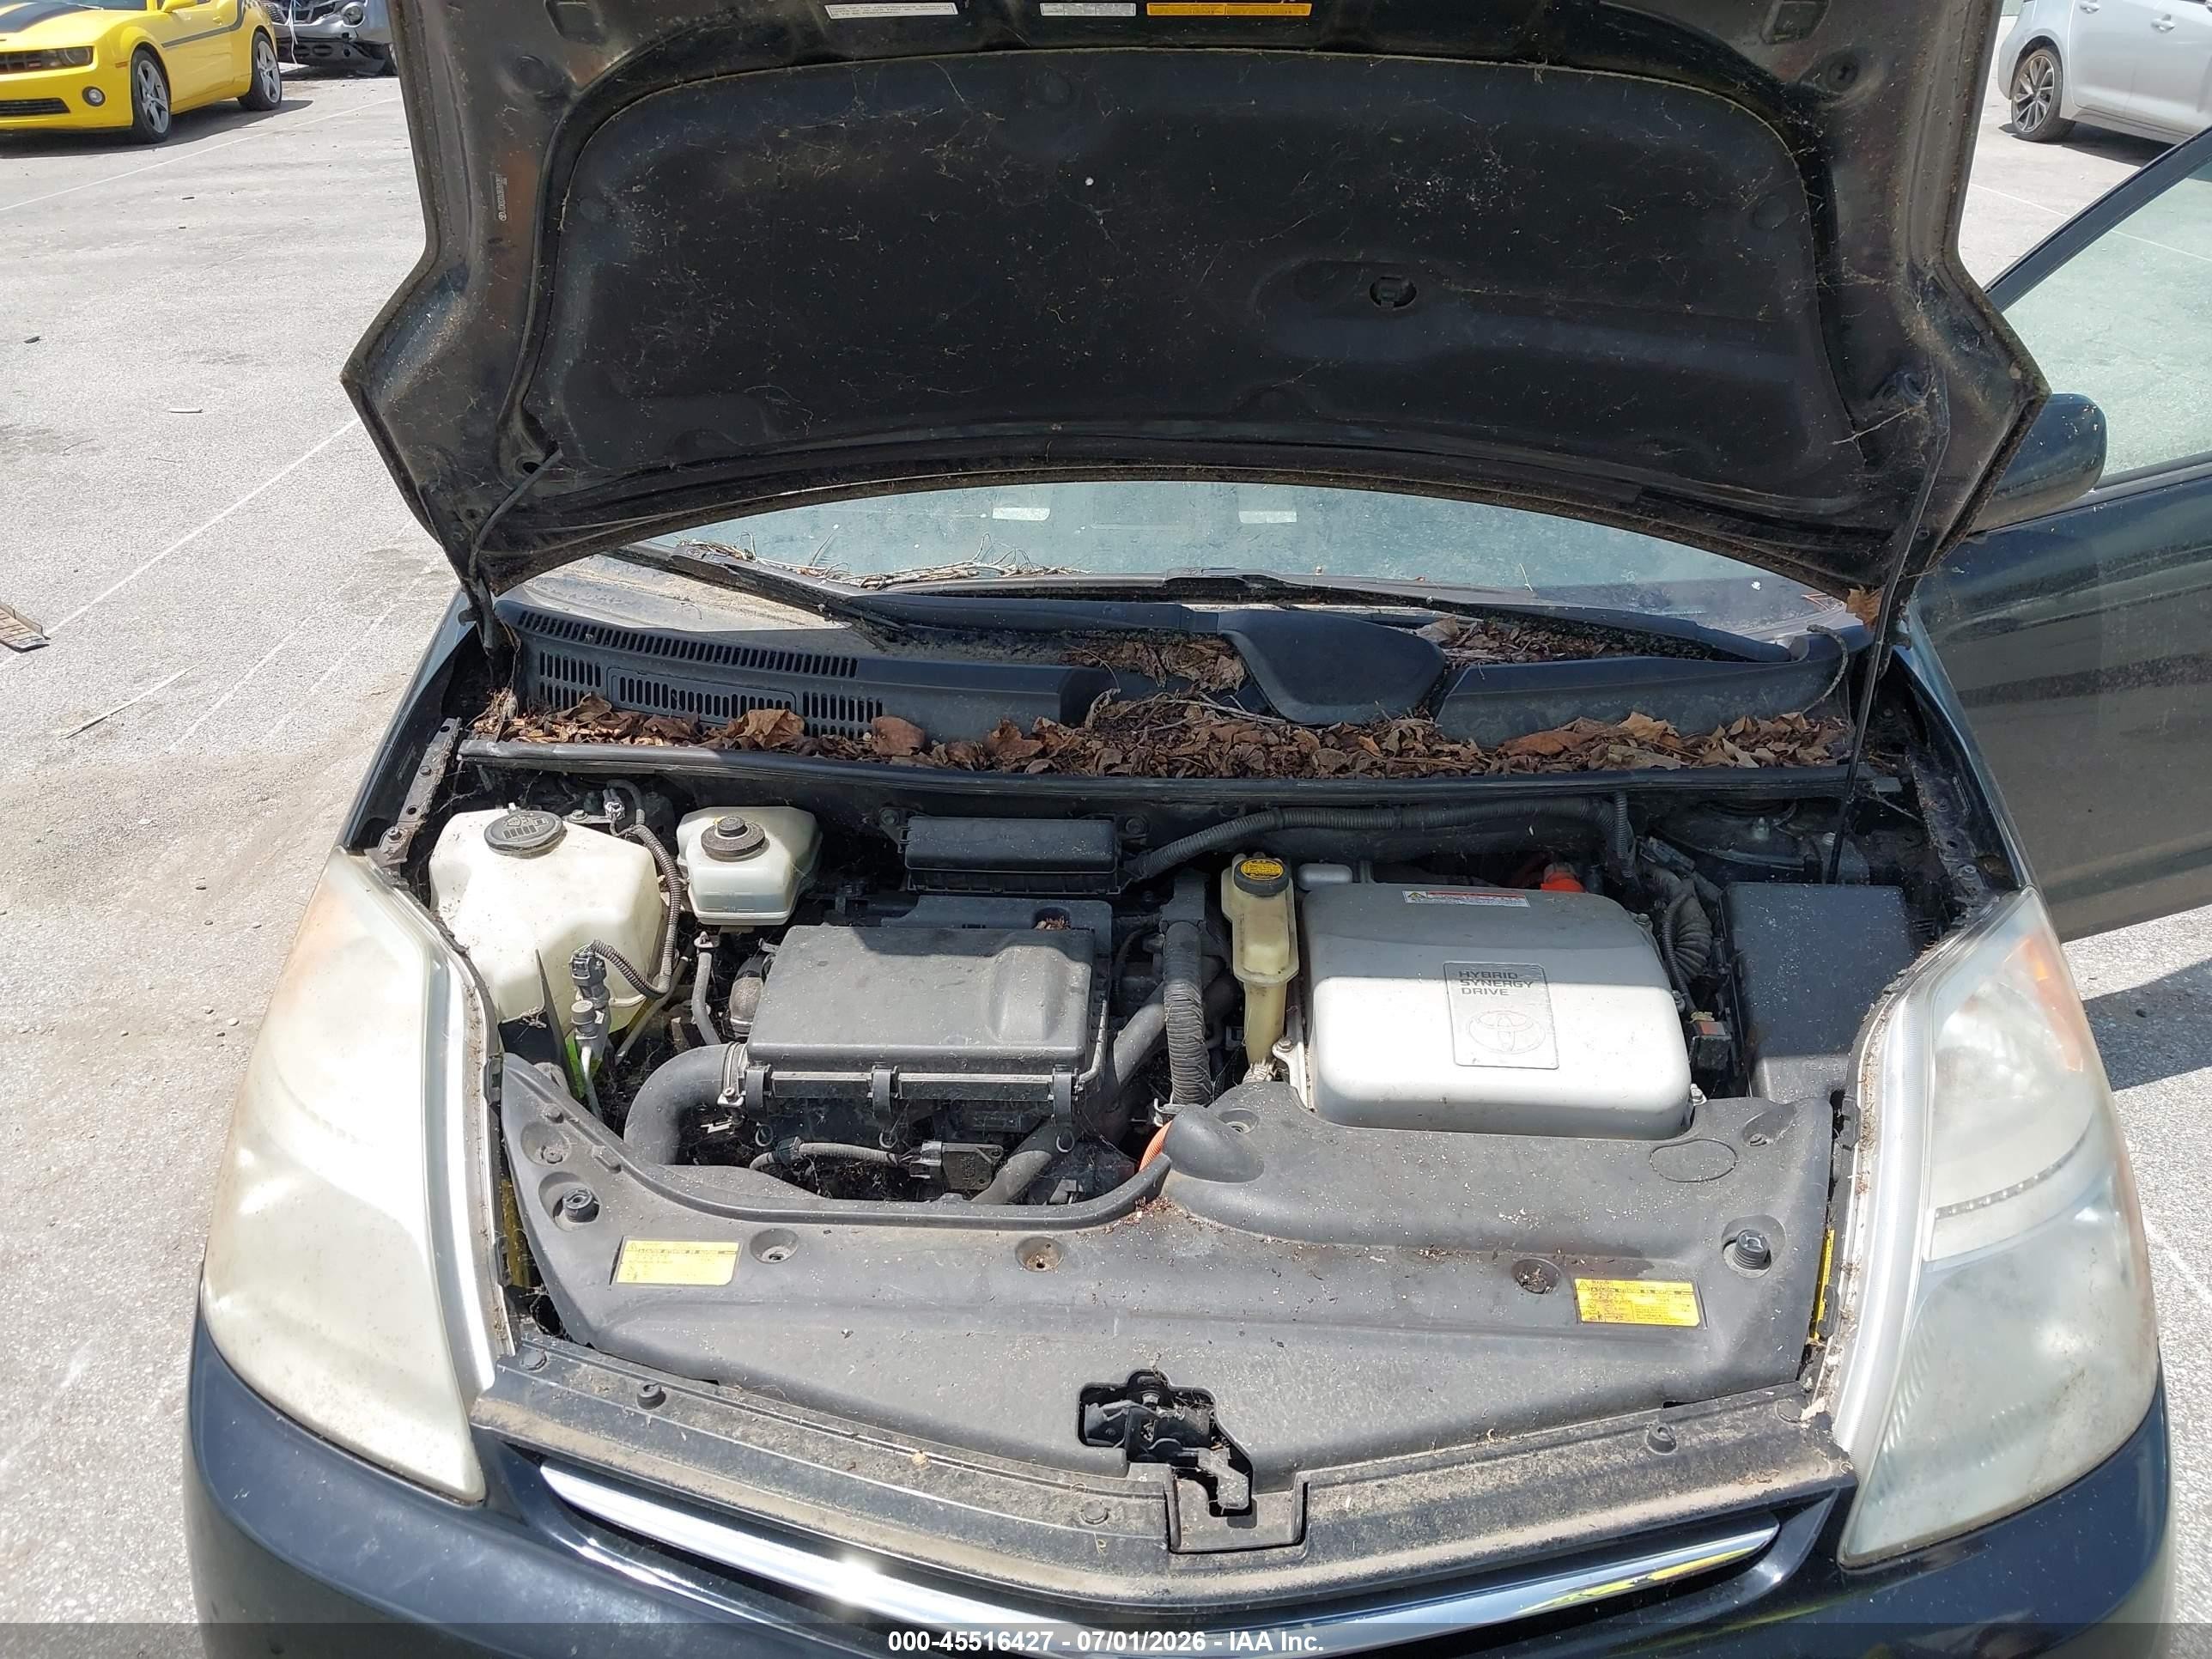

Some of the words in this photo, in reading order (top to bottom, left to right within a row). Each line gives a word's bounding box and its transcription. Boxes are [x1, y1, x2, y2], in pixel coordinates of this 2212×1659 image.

[1458, 970, 1518, 980] HYBRID
[1460, 979, 1534, 988] SYNERGY
[1462, 988, 1510, 996] DRIVE
